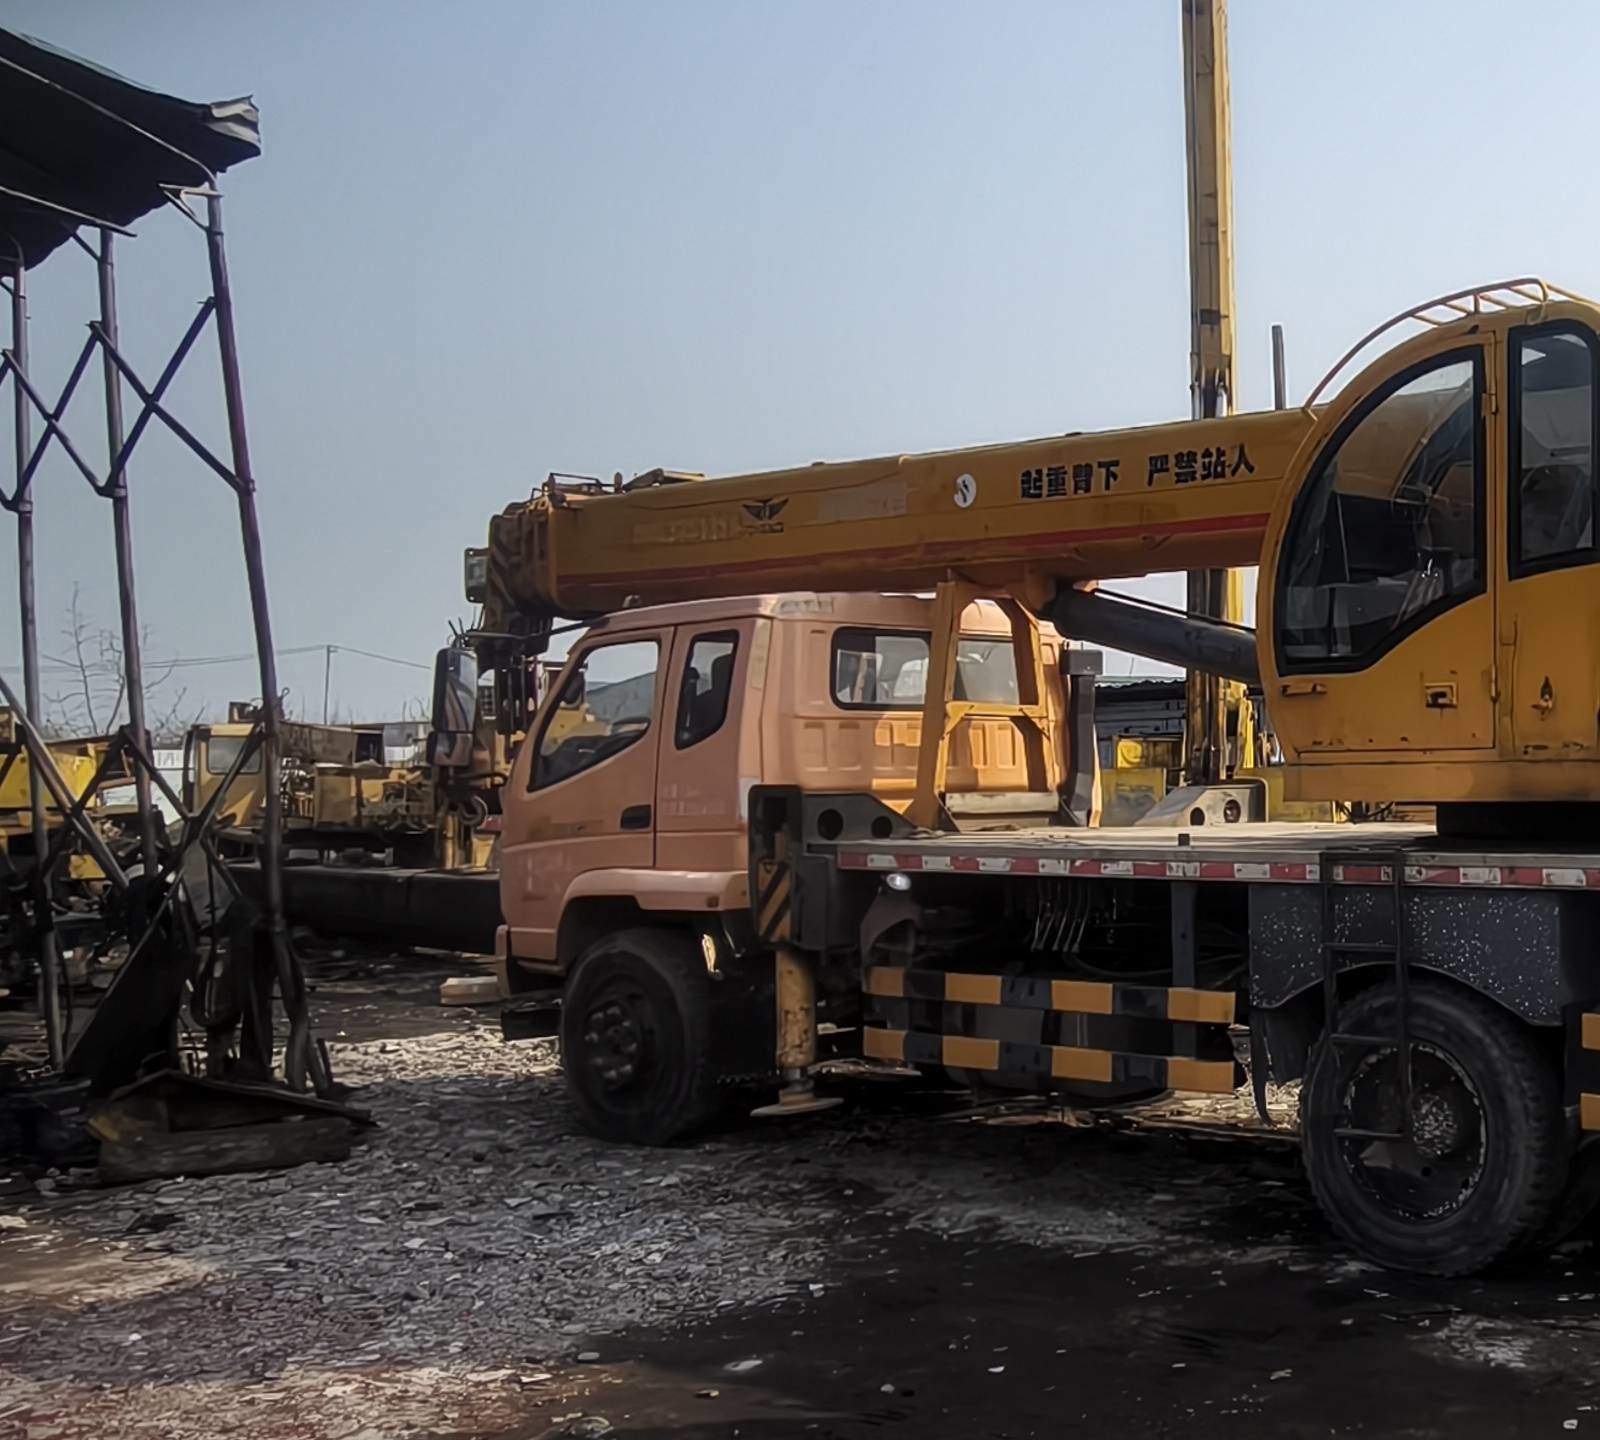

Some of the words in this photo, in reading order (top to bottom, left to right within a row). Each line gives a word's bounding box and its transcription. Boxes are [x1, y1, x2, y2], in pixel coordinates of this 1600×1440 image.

[1020, 460, 1120, 498] 起重臂下
[1147, 443, 1255, 487] 严禁站人
